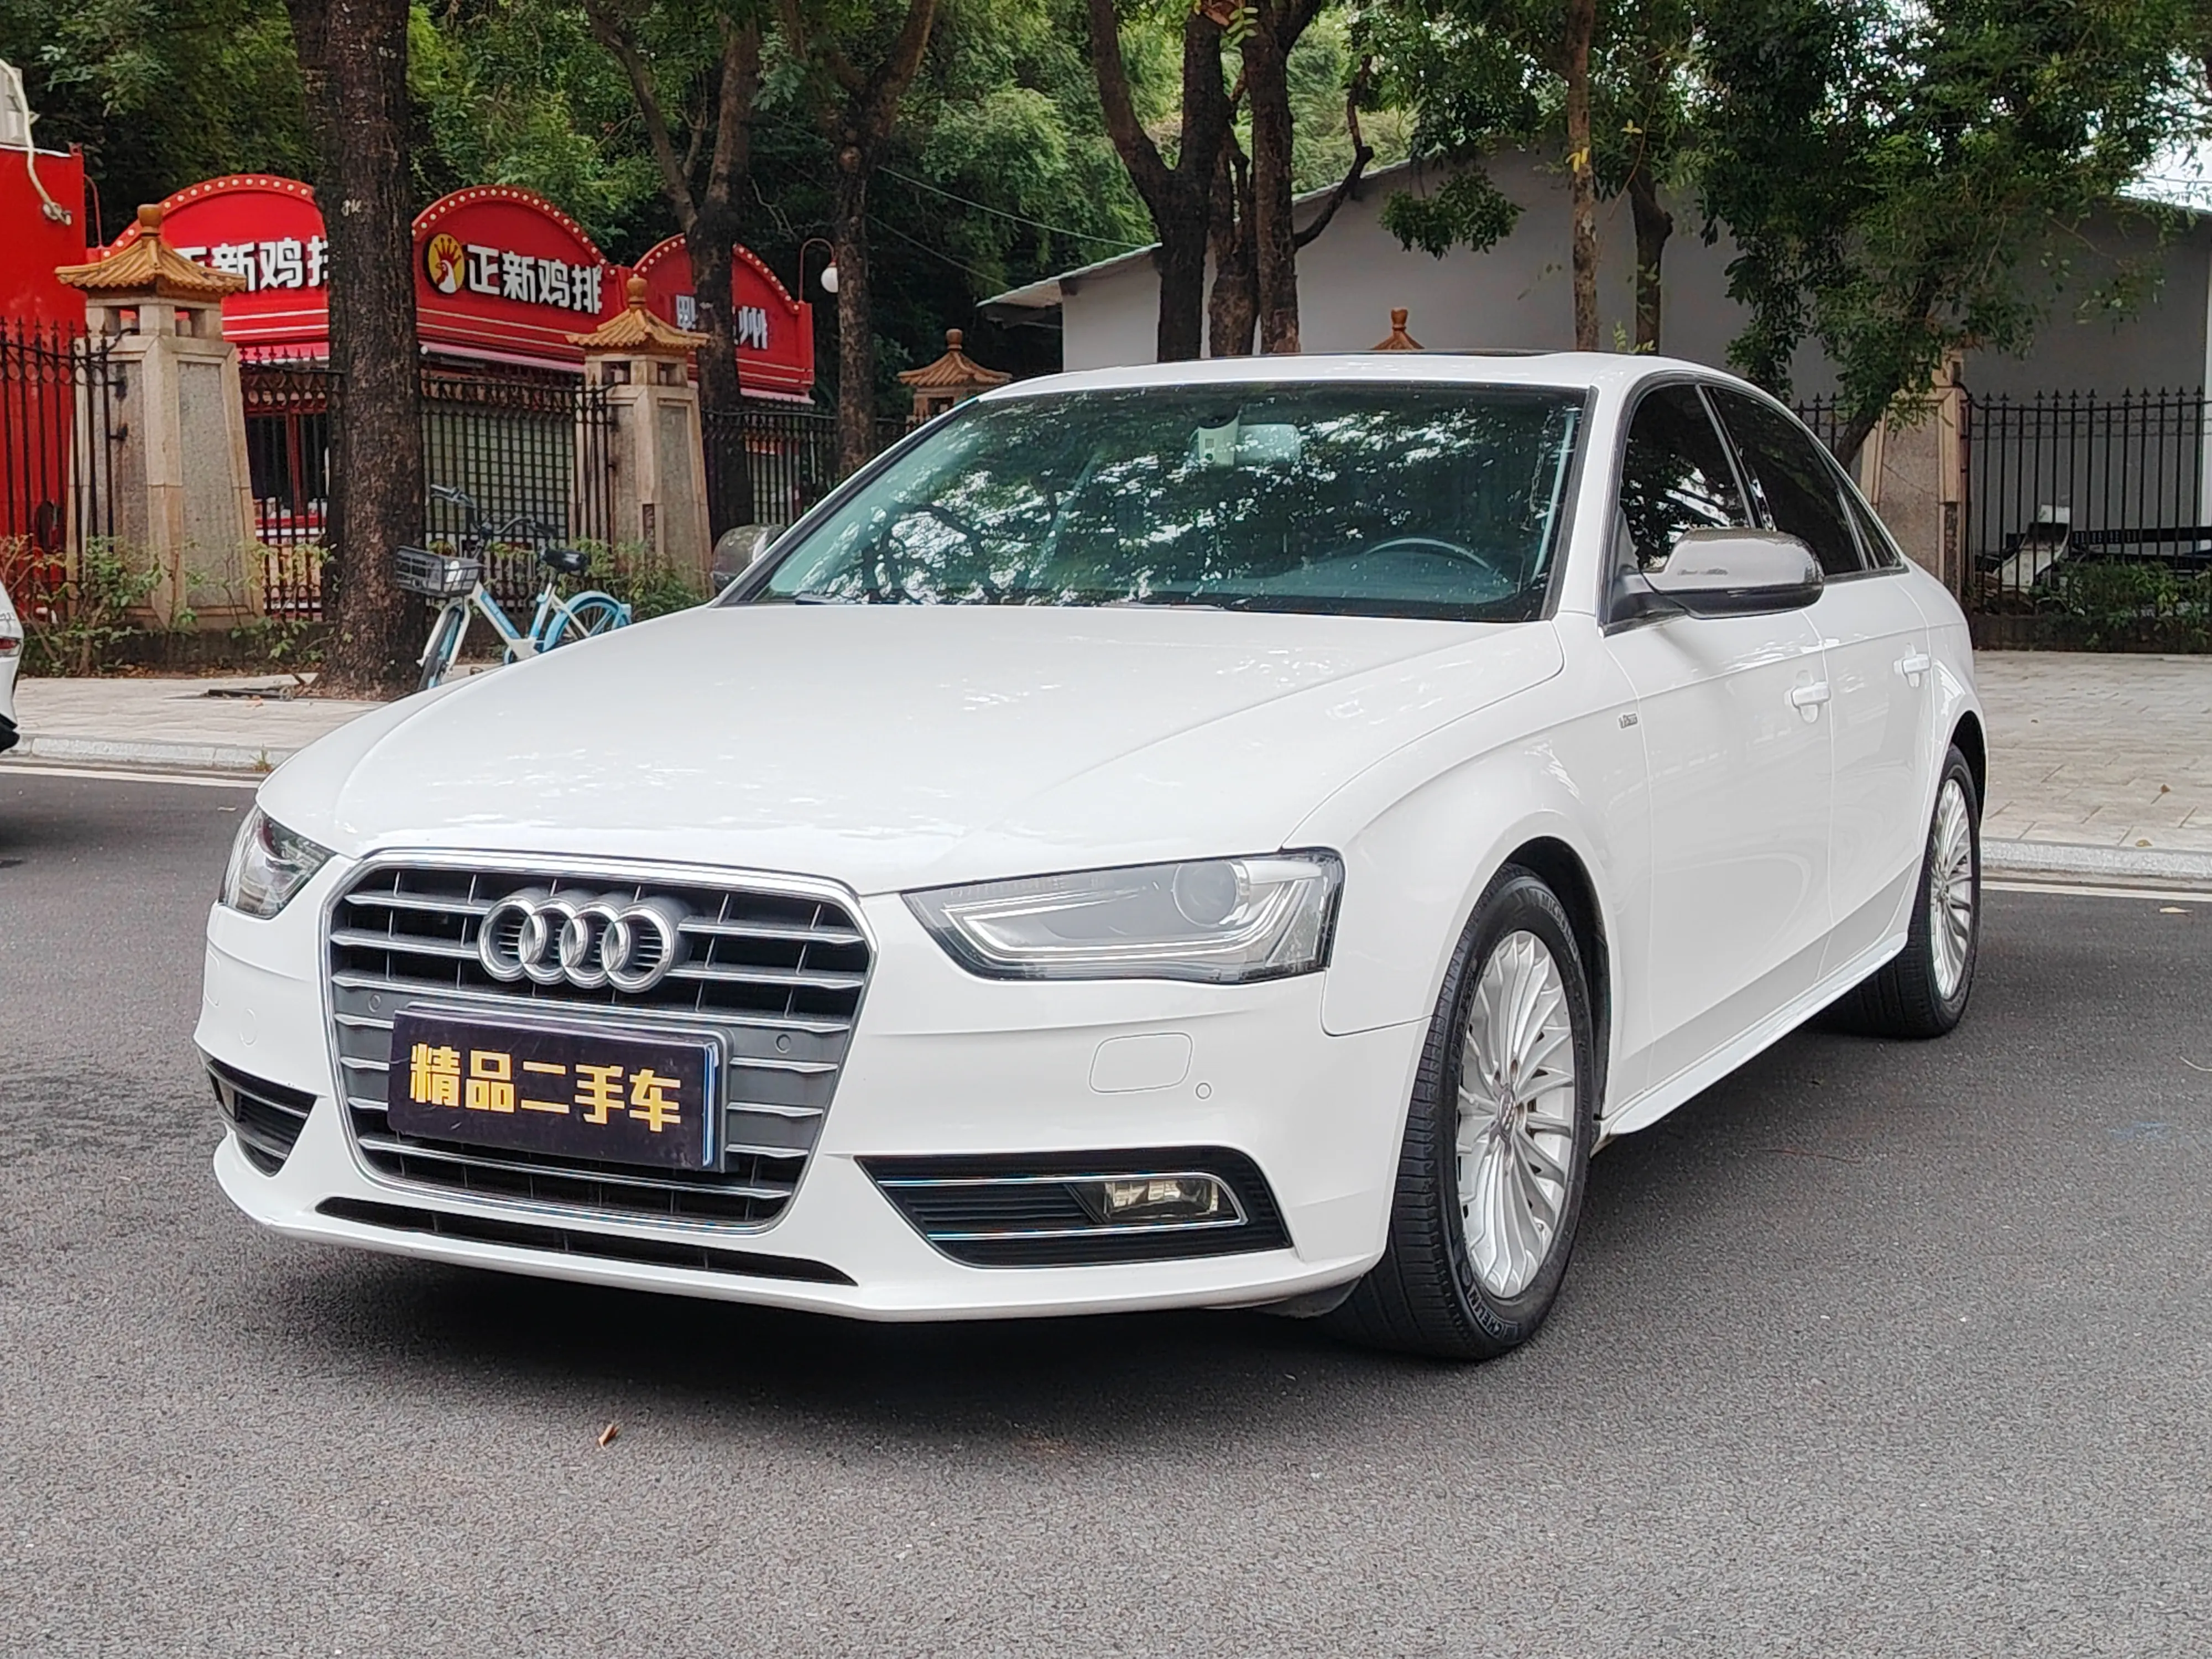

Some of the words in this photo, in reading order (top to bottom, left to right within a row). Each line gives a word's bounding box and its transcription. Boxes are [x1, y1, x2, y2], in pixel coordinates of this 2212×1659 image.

[467, 244, 603, 315] 正新鸡排
[410, 1043, 681, 1132] 精品二手车
